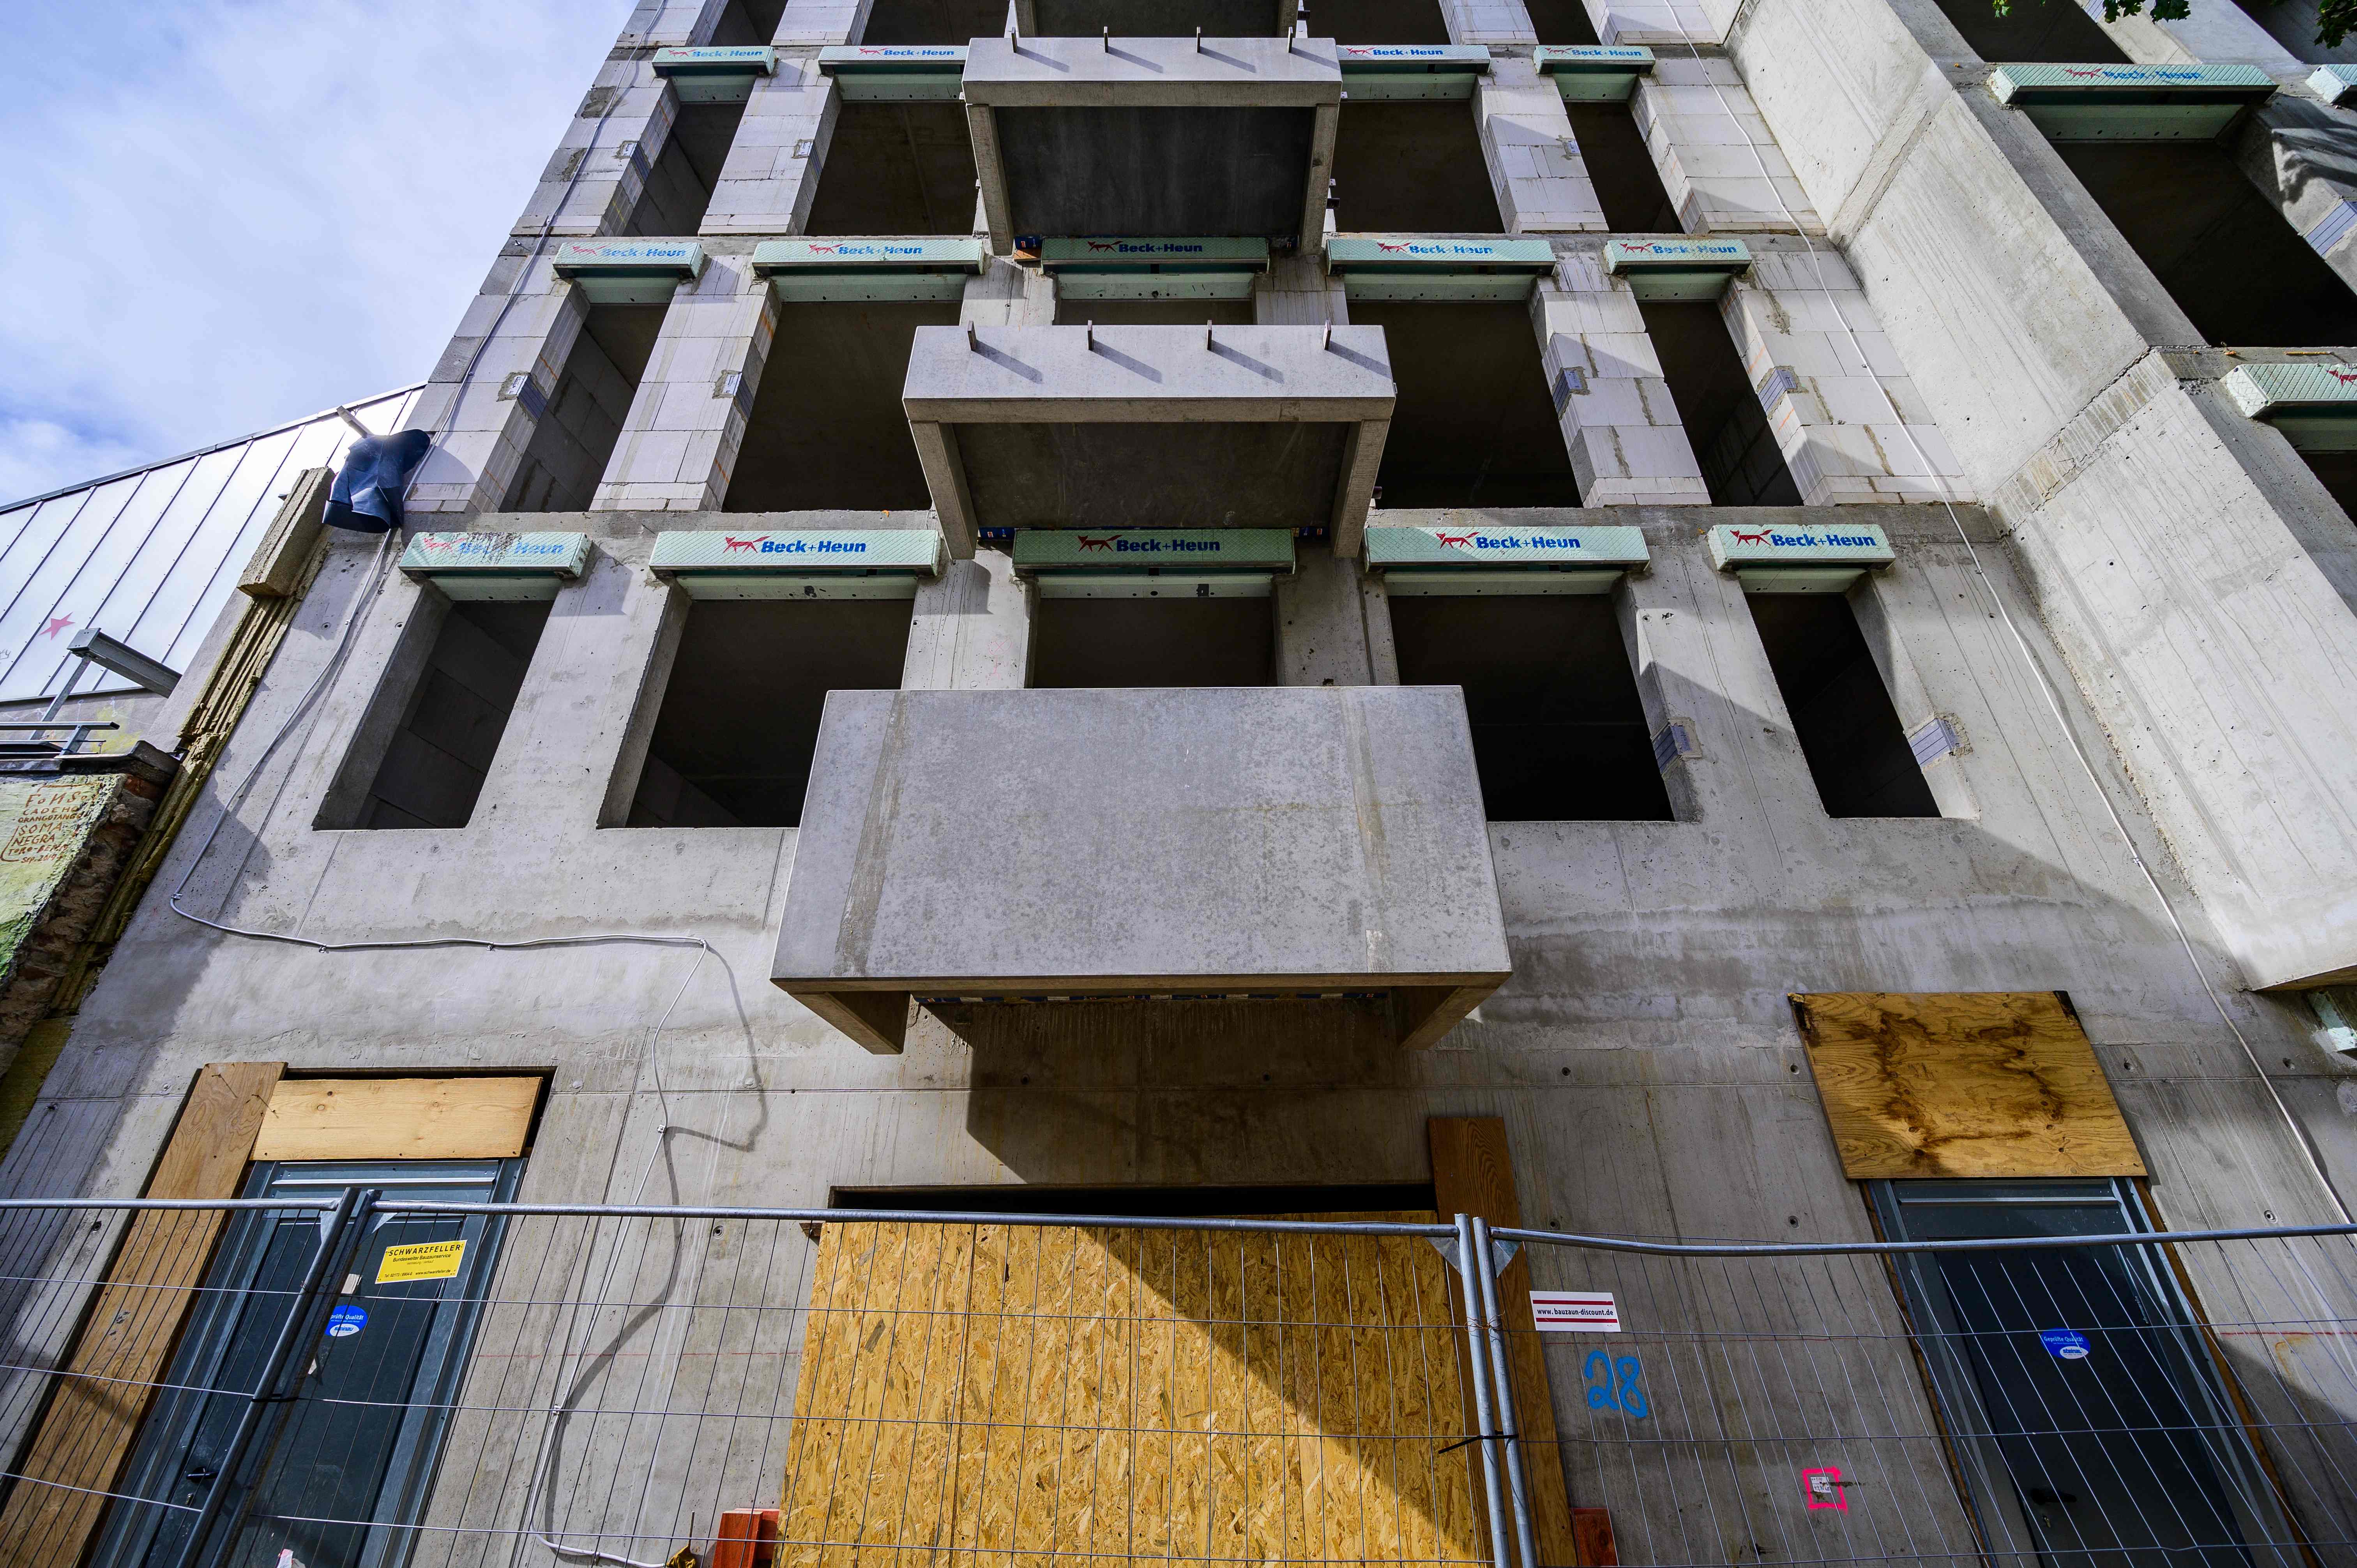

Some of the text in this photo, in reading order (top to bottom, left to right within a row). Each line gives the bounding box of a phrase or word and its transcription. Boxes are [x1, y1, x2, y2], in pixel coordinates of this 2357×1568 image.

[1118, 243, 1203, 253] Beck+Heun
[1116, 539, 1220, 552] Beck+Heun
[1475, 535, 1581, 549] Beck+Heun
[1770, 533, 1876, 546] Beck+Heun
[761, 540, 866, 553] Beck+Heun
[19, 822, 63, 836] SOMA
[11, 833, 55, 847] NEGRA
[389, 1244, 460, 1256] SCHWARZFELLER
[1584, 1350, 1648, 1418] 28
